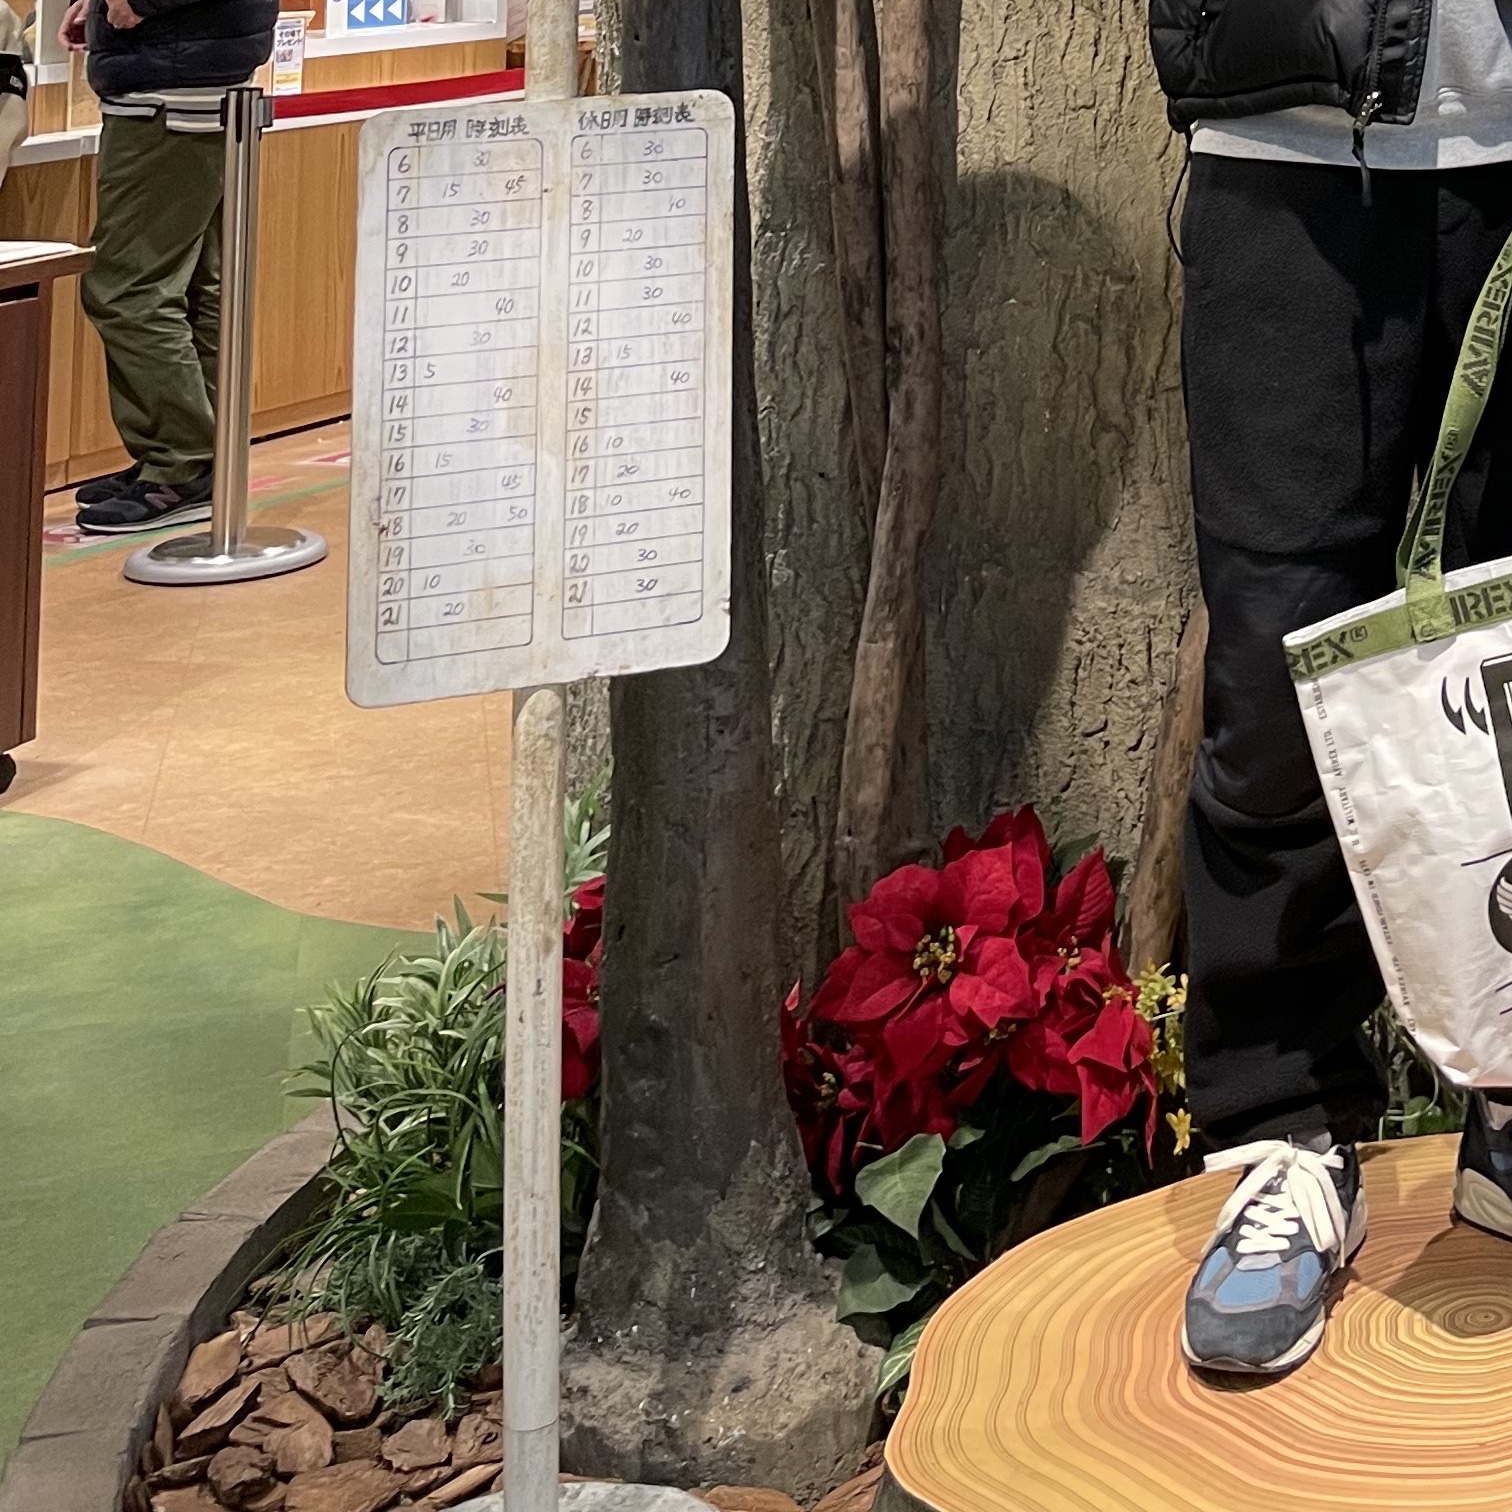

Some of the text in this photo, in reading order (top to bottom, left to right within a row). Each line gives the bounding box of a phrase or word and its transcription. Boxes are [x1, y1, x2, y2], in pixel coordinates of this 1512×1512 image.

[408, 118, 457, 143] 平日用
[580, 140, 664, 159] 6 30
[397, 153, 410, 174] 6
[396, 175, 527, 206] 7 15 45
[579, 170, 663, 190] 7 30
[582, 200, 593, 218] 8
[397, 210, 491, 234] 8 30
[580, 228, 642, 246] 9 20
[396, 240, 488, 263] 9 30
[575, 256, 662, 277] 10 30
[392, 272, 470, 293] 10 20
[575, 286, 663, 306] 11 30
[392, 297, 514, 323] 11 40
[573, 311, 692, 336] 12 40
[390, 331, 491, 353] 12 30
[573, 345, 631, 363] 13 15
[390, 363, 436, 381] 13 5
[572, 370, 690, 395] 14 40
[388, 388, 512, 413] 14 40
[573, 407, 591, 424] 15
[388, 418, 489, 442] 15 30
[572, 435, 623, 453] 16 10
[387, 453, 452, 471] 16 15
[570, 464, 639, 482] 17 20
[384, 474, 521, 505] 17 45
[570, 488, 691, 513] 18 10 40
[383, 506, 528, 536] 18 20 50
[570, 523, 638, 544] 19 20
[384, 540, 486, 564] 19 30
[569, 548, 657, 572] 20 30
[382, 574, 440, 595] 20 10
[568, 578, 657, 603] 21 30
[382, 602, 465, 624] 21 20
